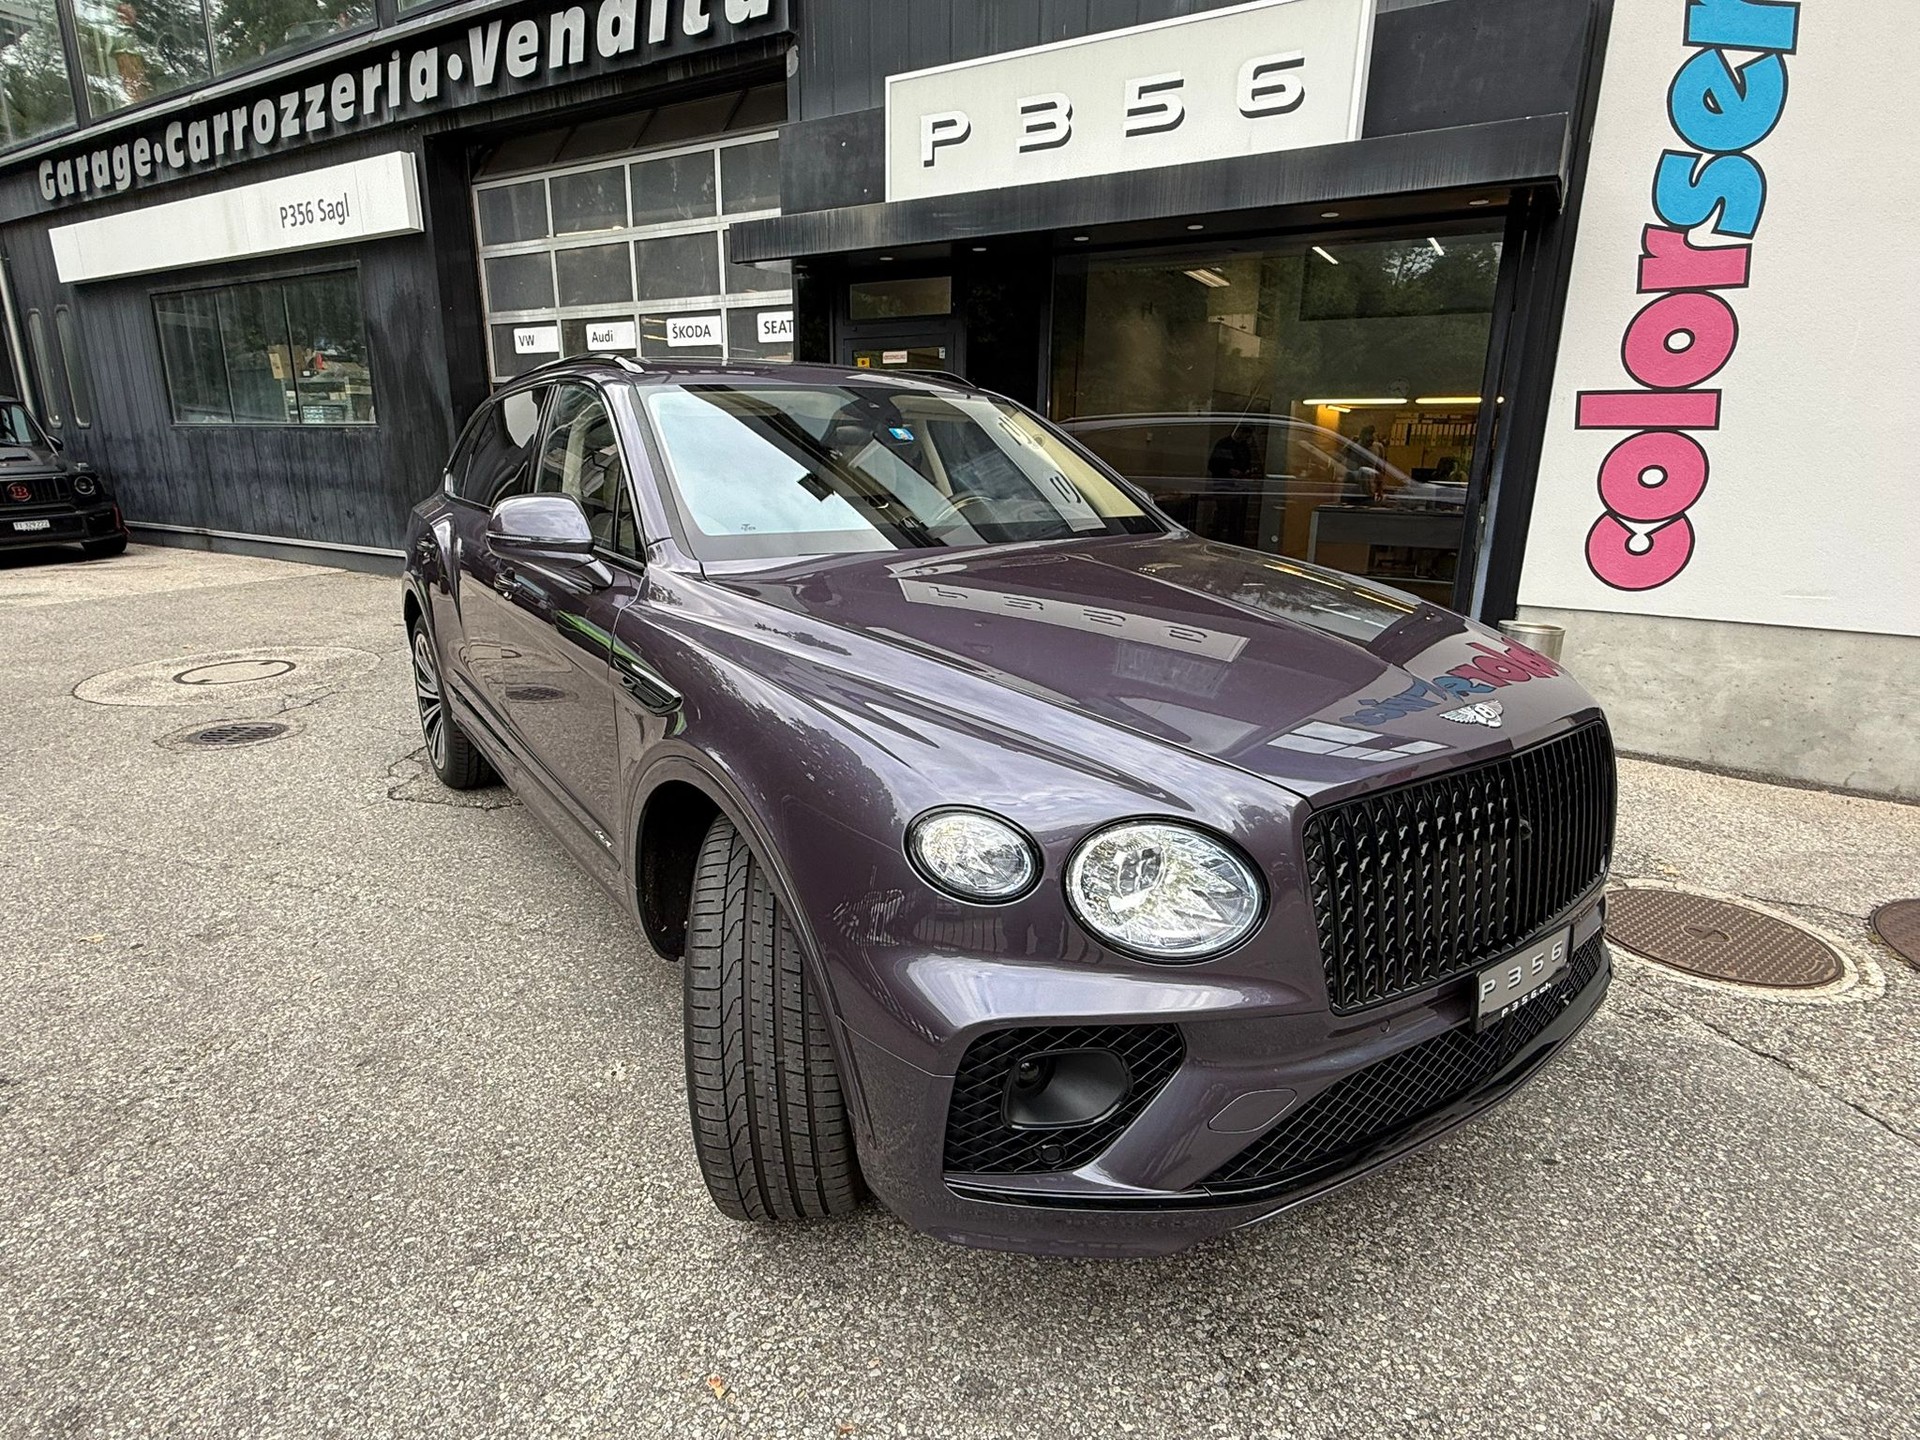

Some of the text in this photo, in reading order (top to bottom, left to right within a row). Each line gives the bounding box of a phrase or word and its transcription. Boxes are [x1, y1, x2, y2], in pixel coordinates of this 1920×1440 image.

[39, 137, 151, 200] Garage
[166, 47, 438, 168] Carrozzeria
[279, 192, 350, 228] P356 Sagl
[672, 323, 711, 339] ŠKODA
[764, 319, 793, 335] SEAT
[518, 334, 535, 347] VW
[591, 330, 614, 343] Audi
